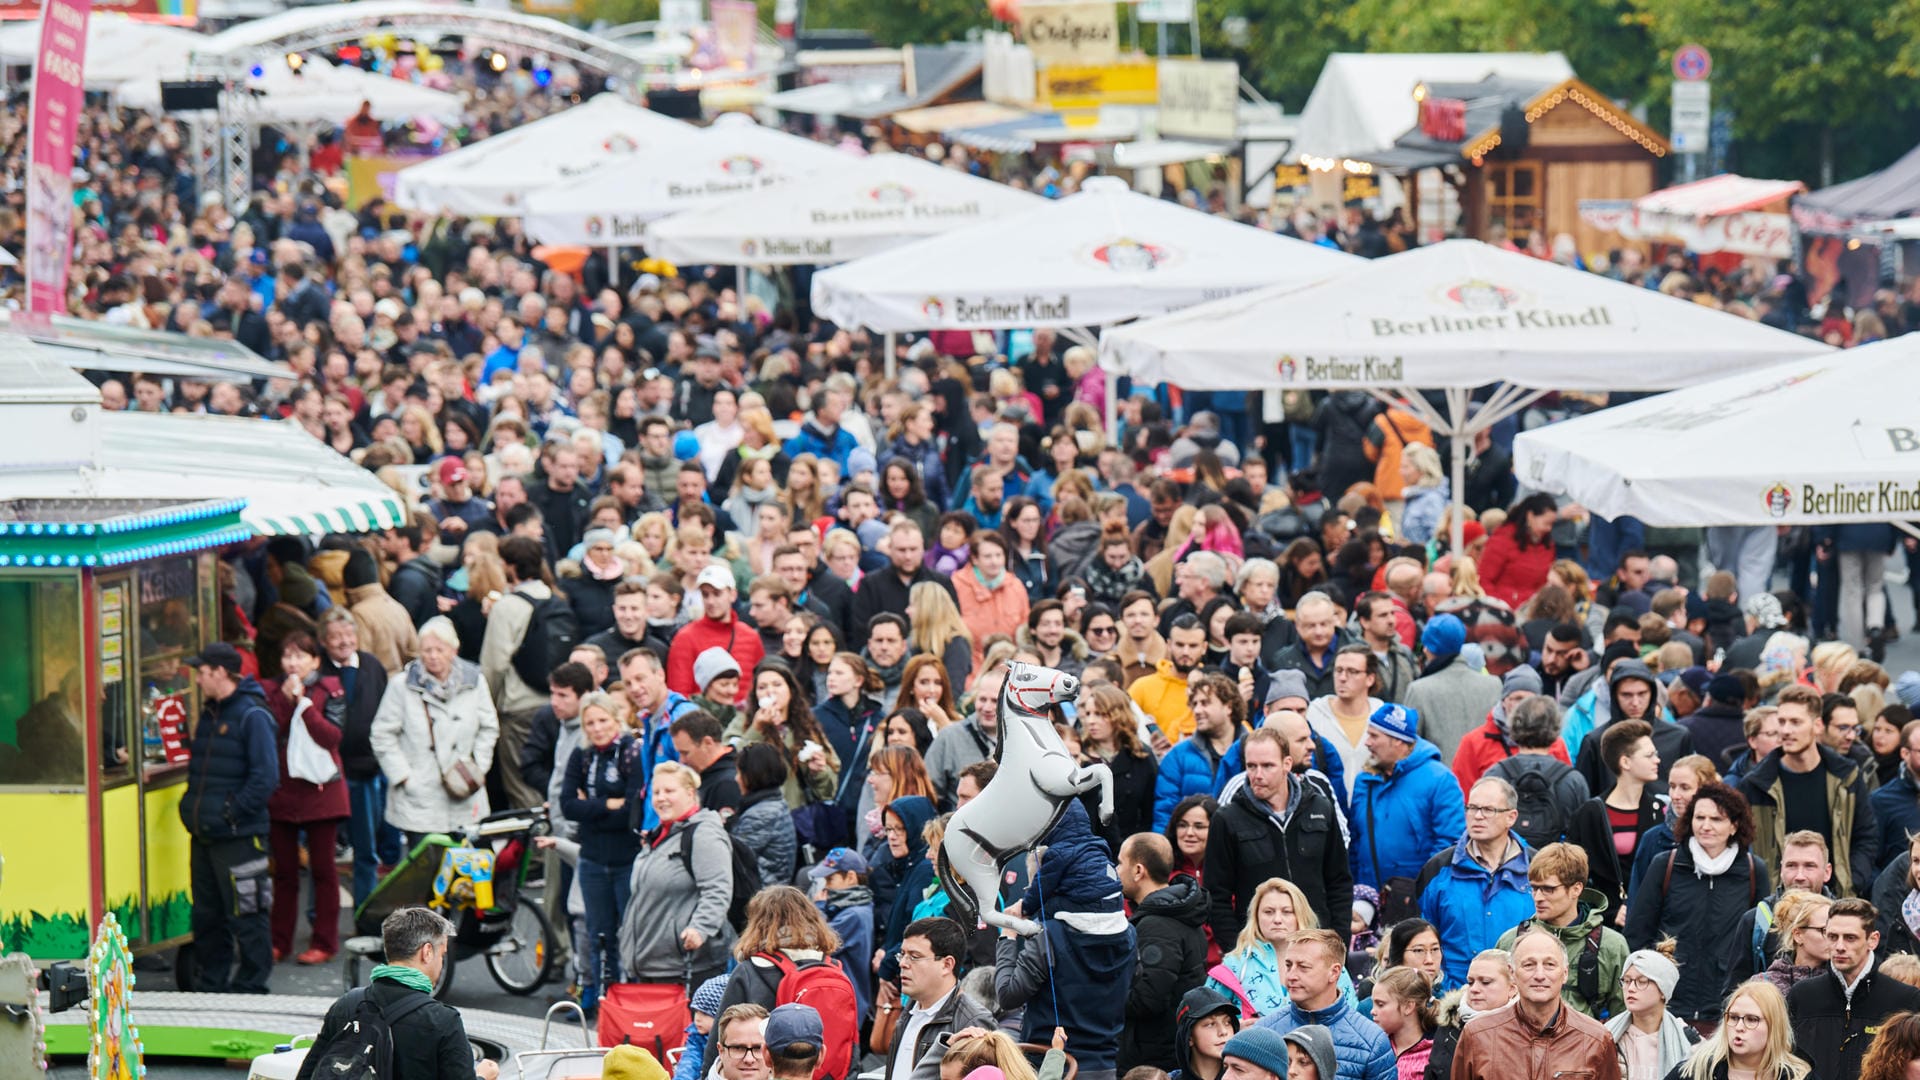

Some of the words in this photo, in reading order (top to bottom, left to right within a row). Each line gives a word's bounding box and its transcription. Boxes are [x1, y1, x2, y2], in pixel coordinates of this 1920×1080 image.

[954, 296, 1020, 322] Berliner
[1023, 294, 1071, 321] Kindl
[1370, 307, 1507, 337] Berliner
[1512, 299, 1612, 329] Kindl
[1305, 355, 1362, 382] Berliner
[1363, 355, 1405, 382] Kindl
[1802, 482, 1874, 515] Berliner
[1877, 480, 1920, 513] Kind
